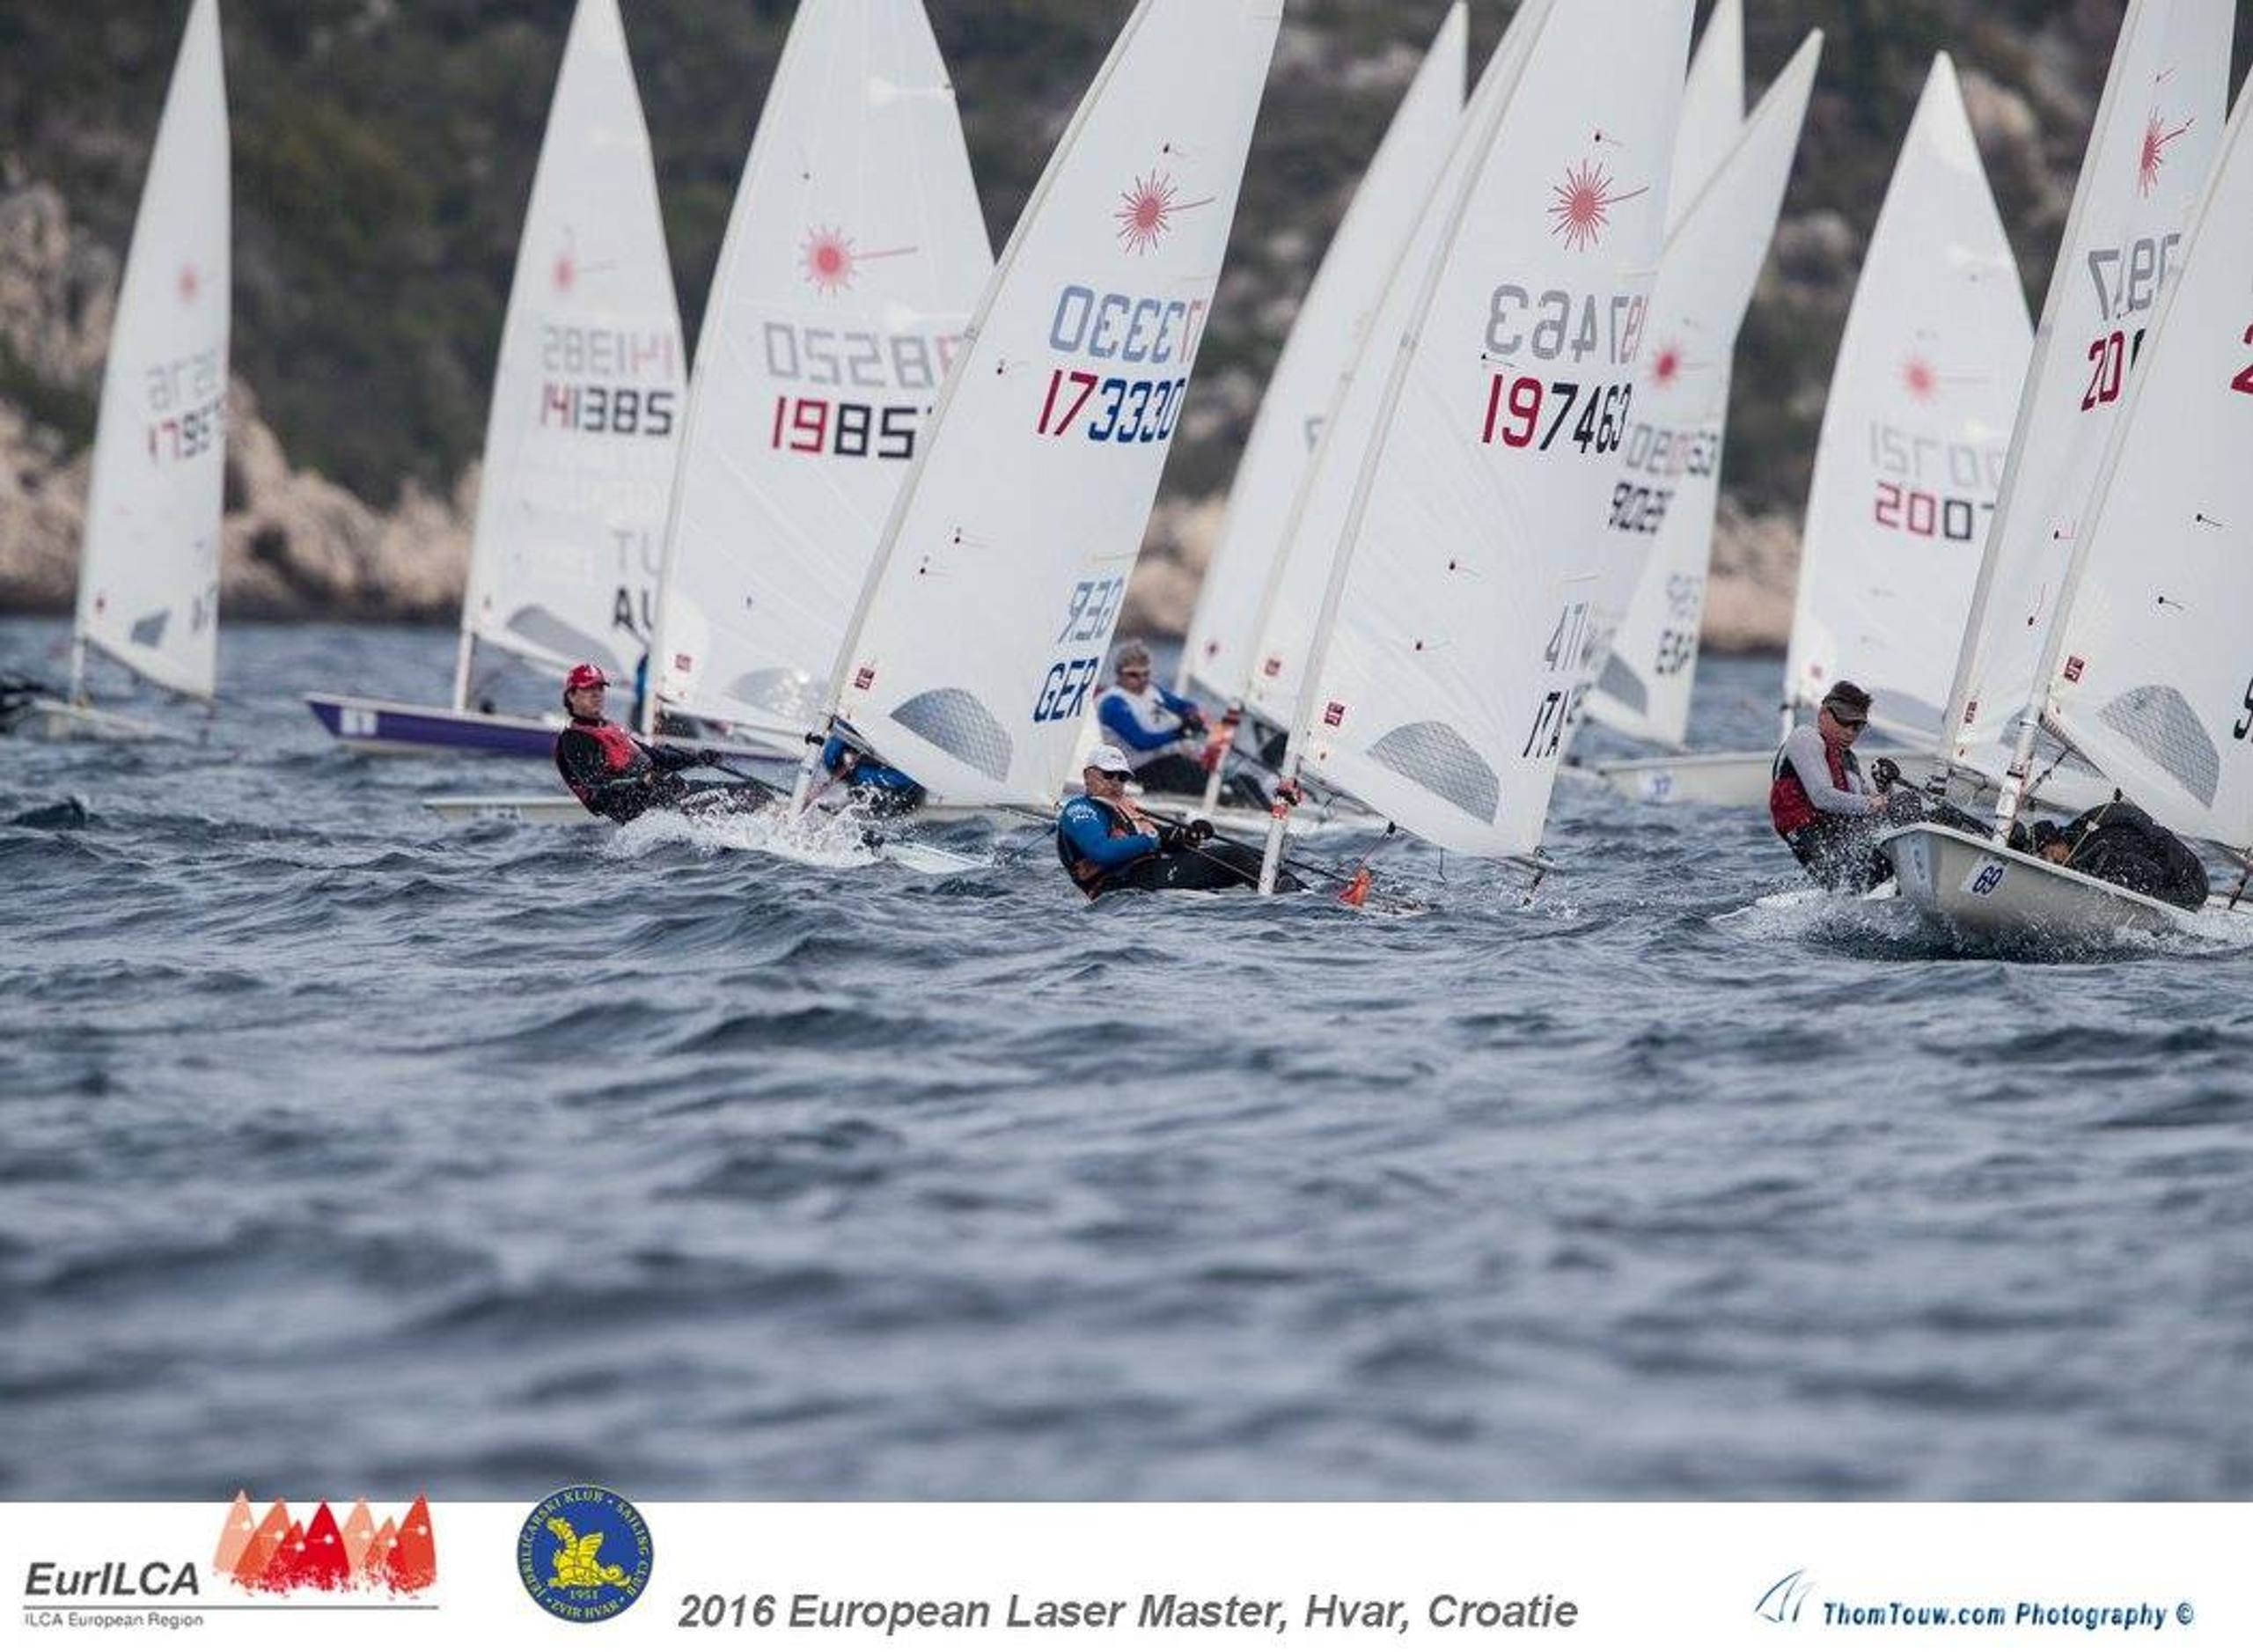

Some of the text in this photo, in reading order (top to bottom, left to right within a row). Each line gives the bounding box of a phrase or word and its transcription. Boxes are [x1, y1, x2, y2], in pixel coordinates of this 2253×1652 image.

[2081, 330, 2147, 411] 20
[540, 378, 675, 437] 141385
[772, 395, 933, 459] 1985
[1037, 368, 1187, 443] 173330
[1482, 373, 1633, 453] 197463
[1875, 480, 1995, 540] 200
[1033, 656, 1099, 723] GER
[1971, 864, 2004, 896] 69
